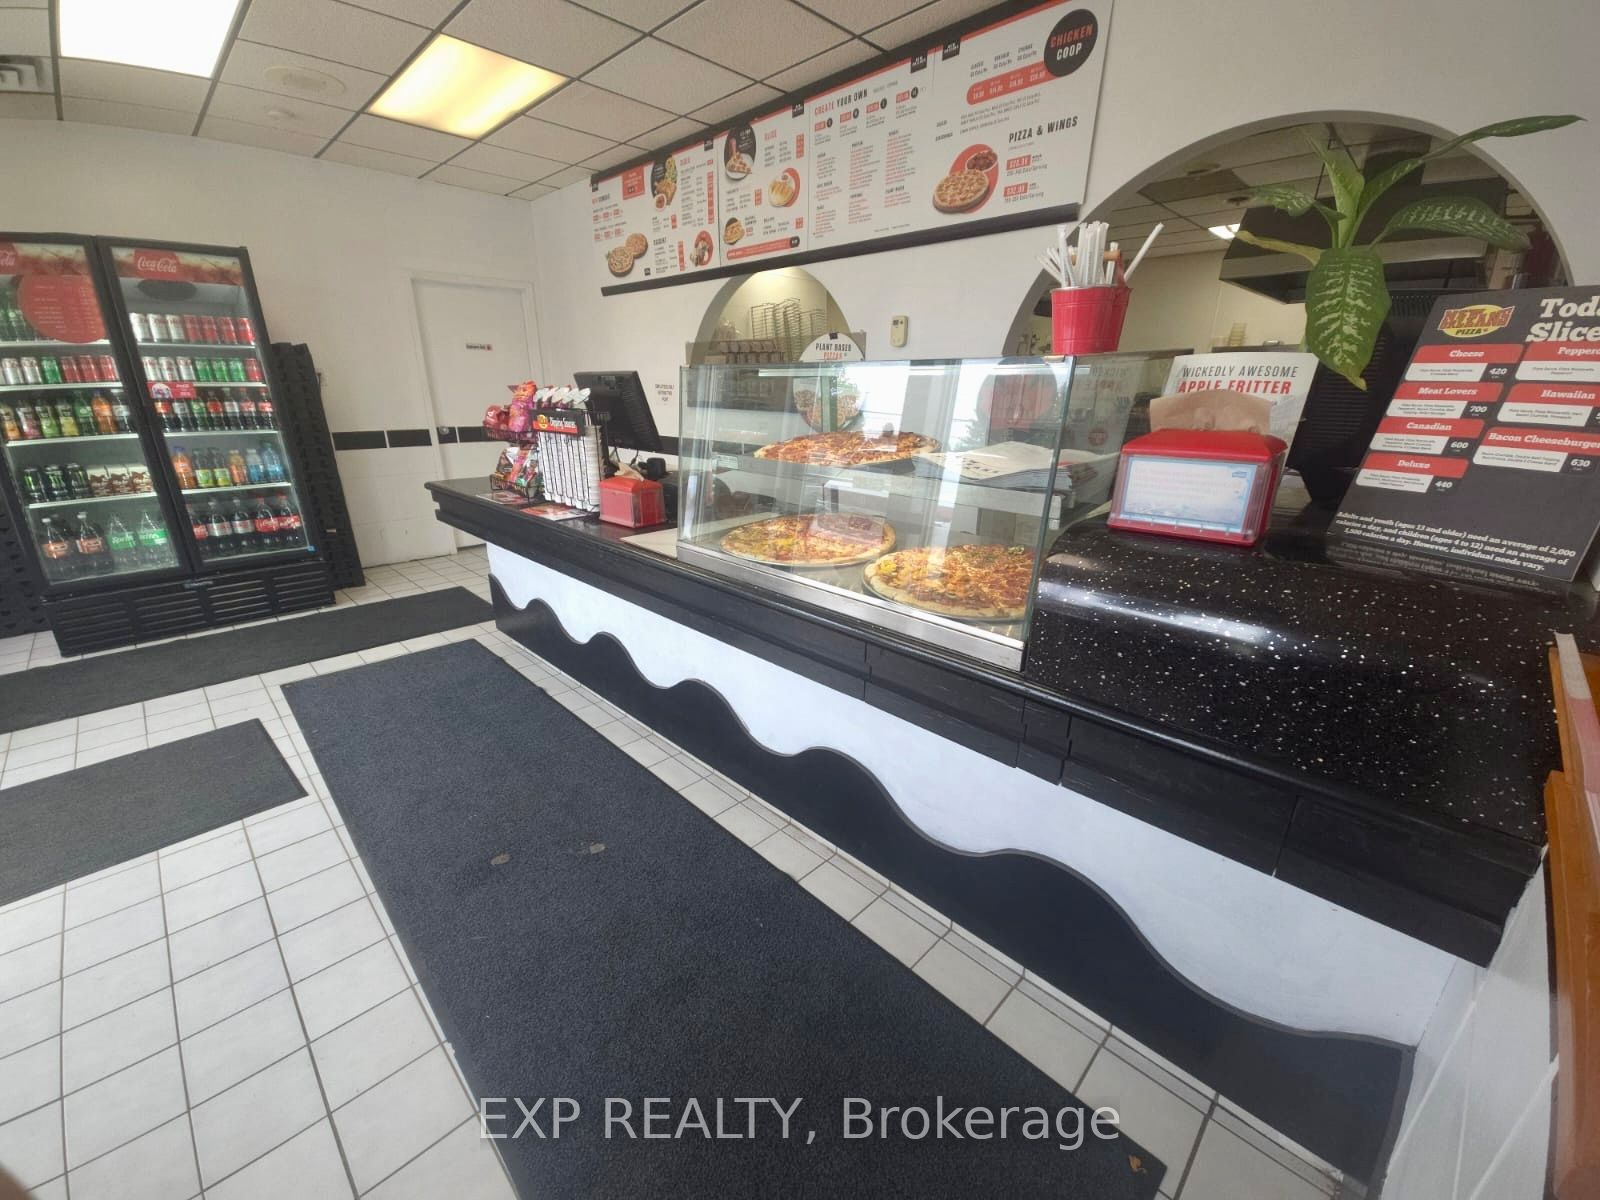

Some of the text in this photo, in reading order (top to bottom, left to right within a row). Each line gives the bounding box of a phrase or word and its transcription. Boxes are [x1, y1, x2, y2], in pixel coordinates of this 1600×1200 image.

[1050, 23, 1093, 48] CHICKEN
[1056, 42, 1082, 60] COOP
[814, 88, 868, 116] CREATE YOUR OWN
[1008, 115, 1079, 143] PIZZA & WINGS
[1455, 328, 1482, 336] PIZZA
[815, 342, 852, 352] PLANT BASED
[1449, 349, 1485, 358] Cheese
[1182, 365, 1299, 378] WICKEDLY AWESOME
[1489, 367, 1508, 375] 420
[1178, 380, 1292, 394] APPLE FRITTER
[1417, 387, 1478, 396] Meat Lovers
[1540, 389, 1596, 400] Hawaiian
[1469, 405, 1488, 413] 700
[1406, 422, 1452, 431] Canadian
[1488, 432, 1522, 442] Bacon
[1450, 441, 1469, 449] 600
[1397, 460, 1431, 469] Deluxe
[1570, 458, 1591, 467] 630
[1374, 518, 1394, 526] youth
[1426, 526, 1442, 534] and
[1442, 529, 1467, 538] older)
[1467, 533, 1488, 541] need
[1501, 540, 1538, 551] average
[1538, 544, 1550, 552] of
[1550, 547, 1576, 557] 2,000
[1362, 530, 1390, 541] calories
[1412, 540, 1449, 552] However,
[1450, 547, 1495, 561] individual
[1494, 555, 1521, 566] needs
[1522, 561, 1545, 571] vary.
[1398, 530, 1430, 540] children
[1430, 534, 1453, 544] (ages
[1470, 542, 1484, 550] 12)
[1484, 545, 1506, 554] need
[1519, 552, 1557, 563] average
[1557, 558, 1569, 566] of
